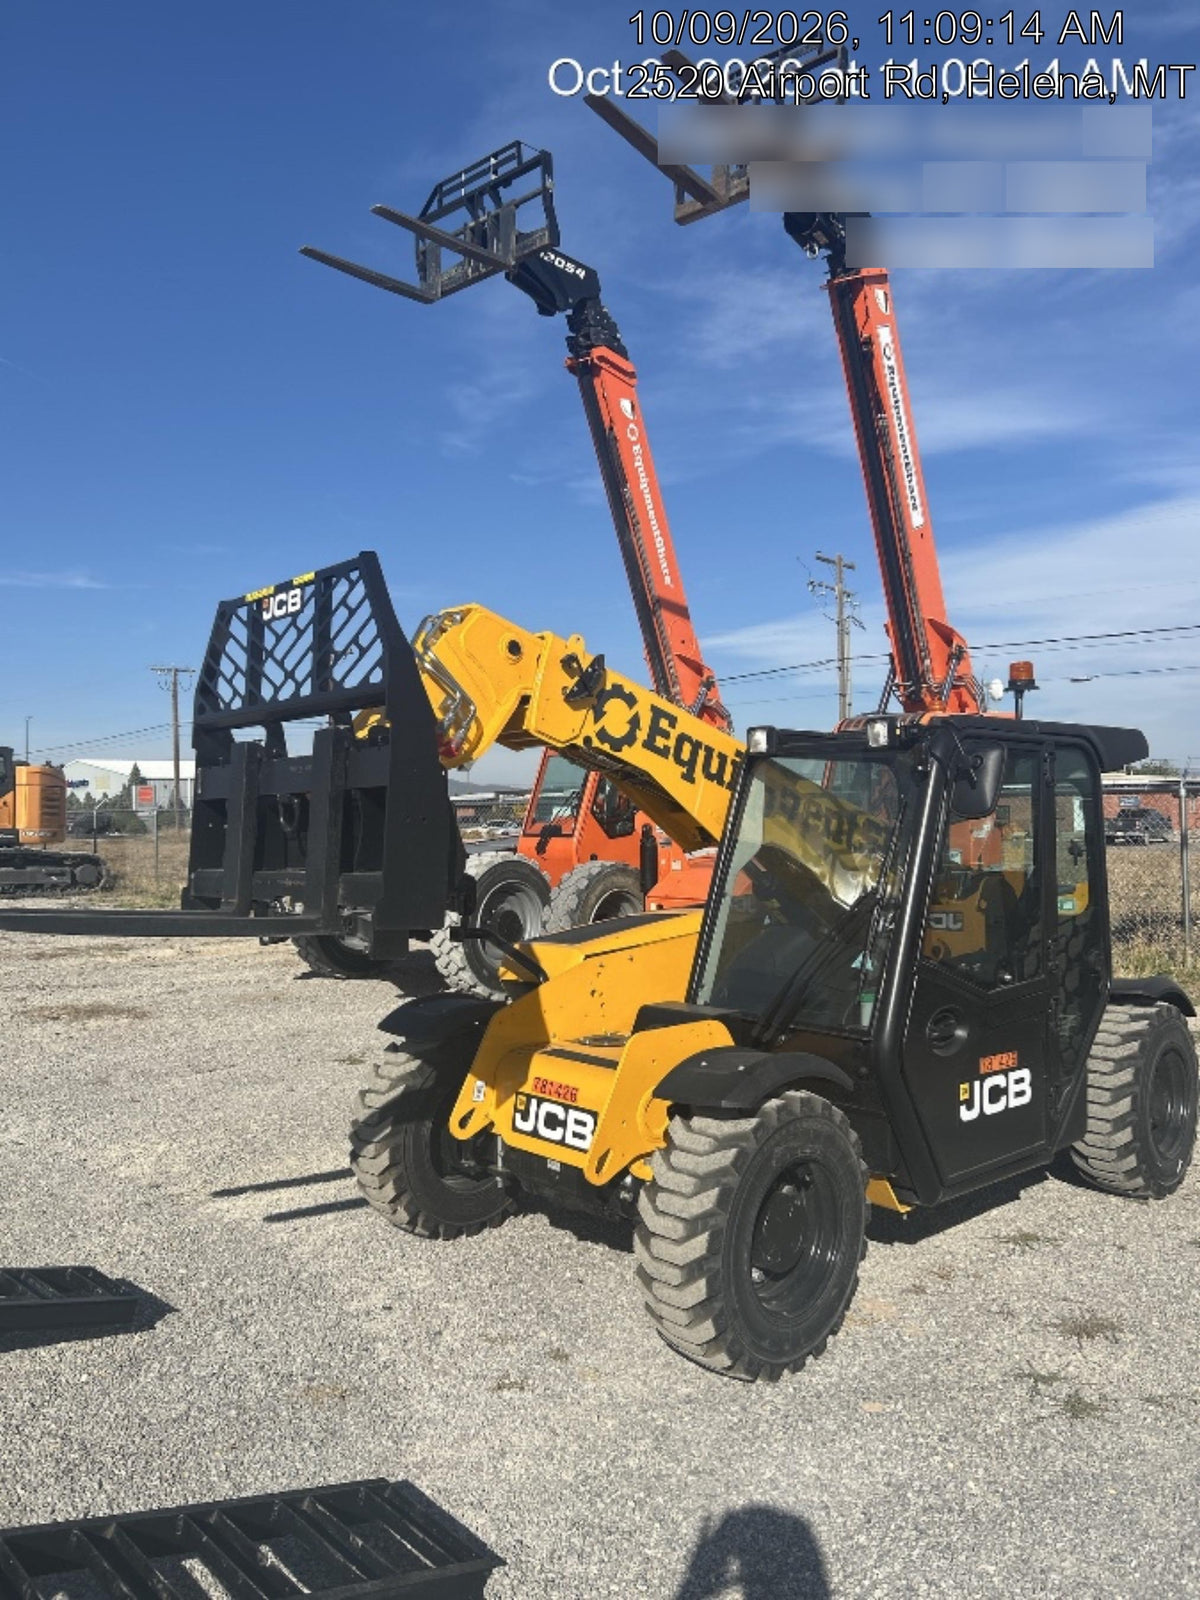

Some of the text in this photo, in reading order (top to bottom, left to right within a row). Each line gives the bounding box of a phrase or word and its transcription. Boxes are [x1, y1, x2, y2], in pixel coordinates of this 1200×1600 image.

[262, 587, 302, 621] JCB
[959, 1067, 1032, 1122] JCB
[514, 1096, 596, 1151] JCB
